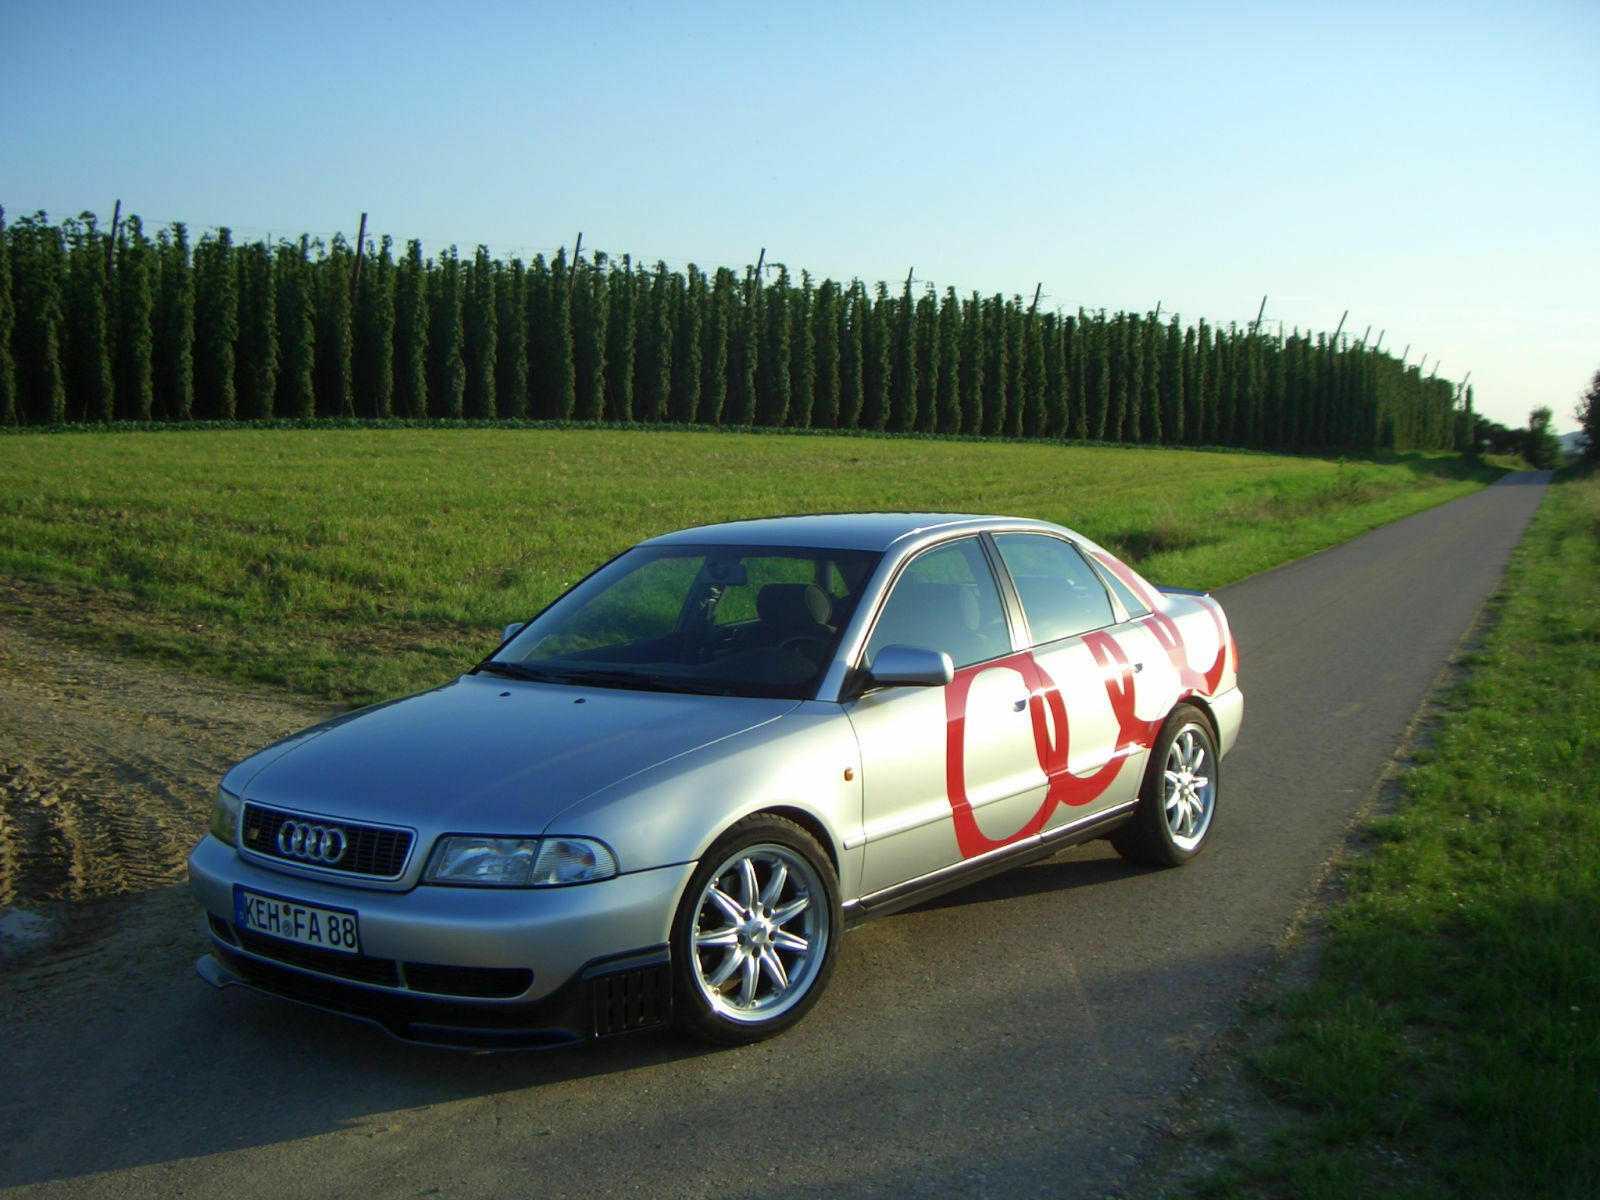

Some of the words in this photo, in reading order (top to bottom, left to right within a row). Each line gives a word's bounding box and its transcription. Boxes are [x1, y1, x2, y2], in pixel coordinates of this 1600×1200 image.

[246, 898, 280, 933] KEH
[293, 908, 322, 943] FA
[327, 915, 357, 949] 88
